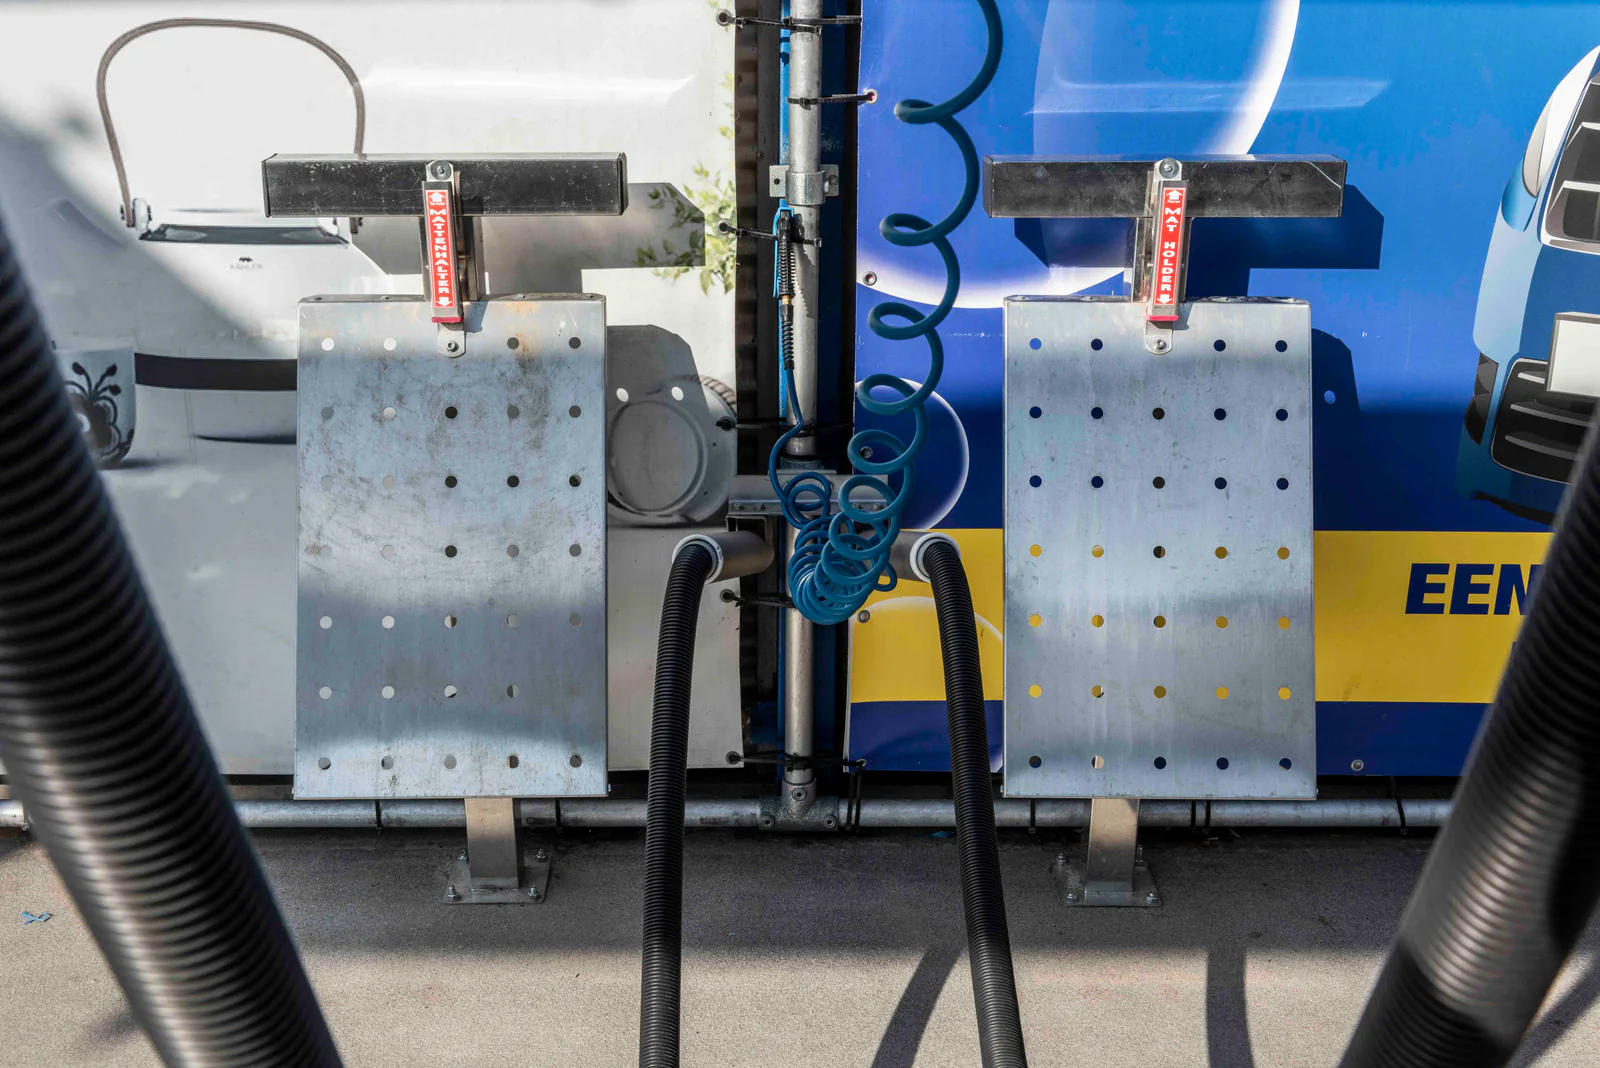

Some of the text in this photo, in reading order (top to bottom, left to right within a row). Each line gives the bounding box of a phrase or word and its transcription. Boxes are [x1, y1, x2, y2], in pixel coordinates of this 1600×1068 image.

[1164, 207, 1181, 232] MAT
[429, 208, 450, 294] MATTENHALTER
[1160, 241, 1176, 292] HOLDER
